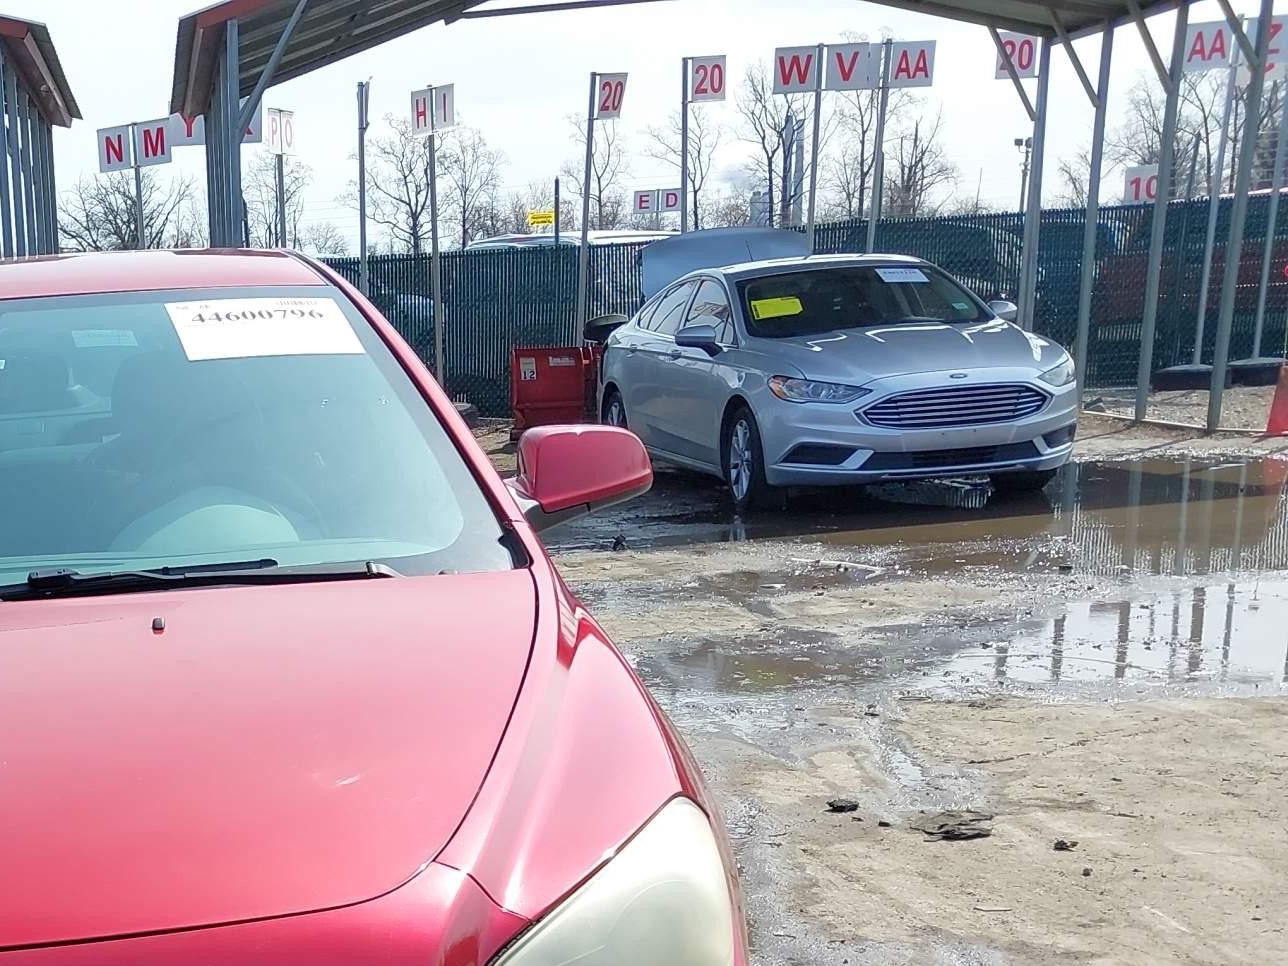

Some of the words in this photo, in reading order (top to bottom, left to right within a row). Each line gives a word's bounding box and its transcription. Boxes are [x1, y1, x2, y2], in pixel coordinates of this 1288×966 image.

[1187, 29, 1226, 63] AA
[694, 63, 723, 95] 20
[778, 54, 813, 85] W
[836, 51, 860, 82] V
[894, 49, 929, 79] AA
[600, 80, 624, 111] 20
[416, 97, 427, 129] H
[143, 127, 165, 158] M
[271, 116, 278, 146] P
[105, 134, 124, 165] N
[638, 194, 650, 210] E
[665, 192, 678, 208] D
